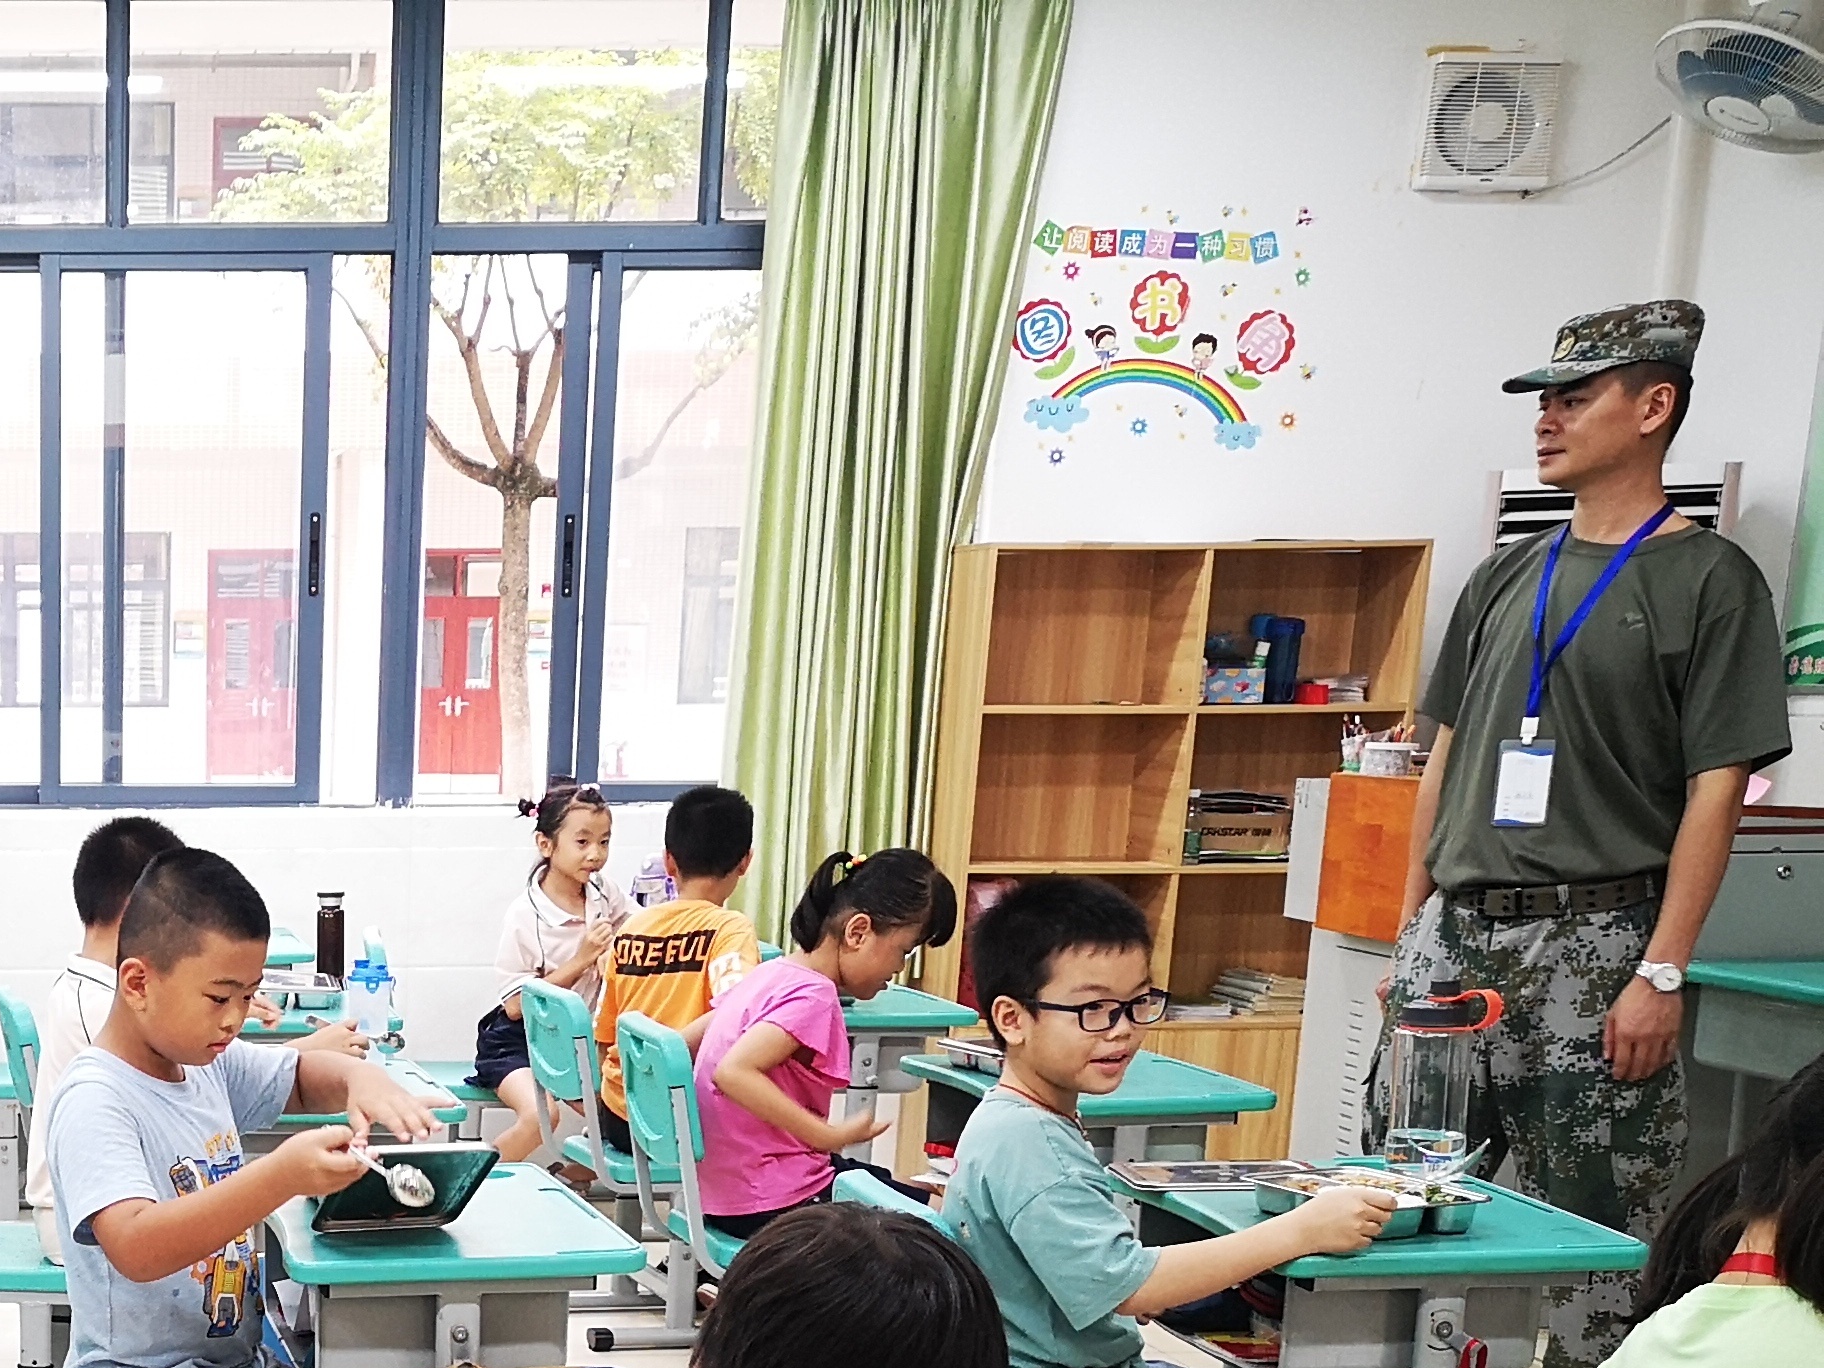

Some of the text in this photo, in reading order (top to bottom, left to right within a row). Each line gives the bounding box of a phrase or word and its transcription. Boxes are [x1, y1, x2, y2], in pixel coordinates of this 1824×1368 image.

[1042, 227, 1277, 260] 让阅读成为一种习惯
[1019, 277, 1291, 373] 图 书 角
